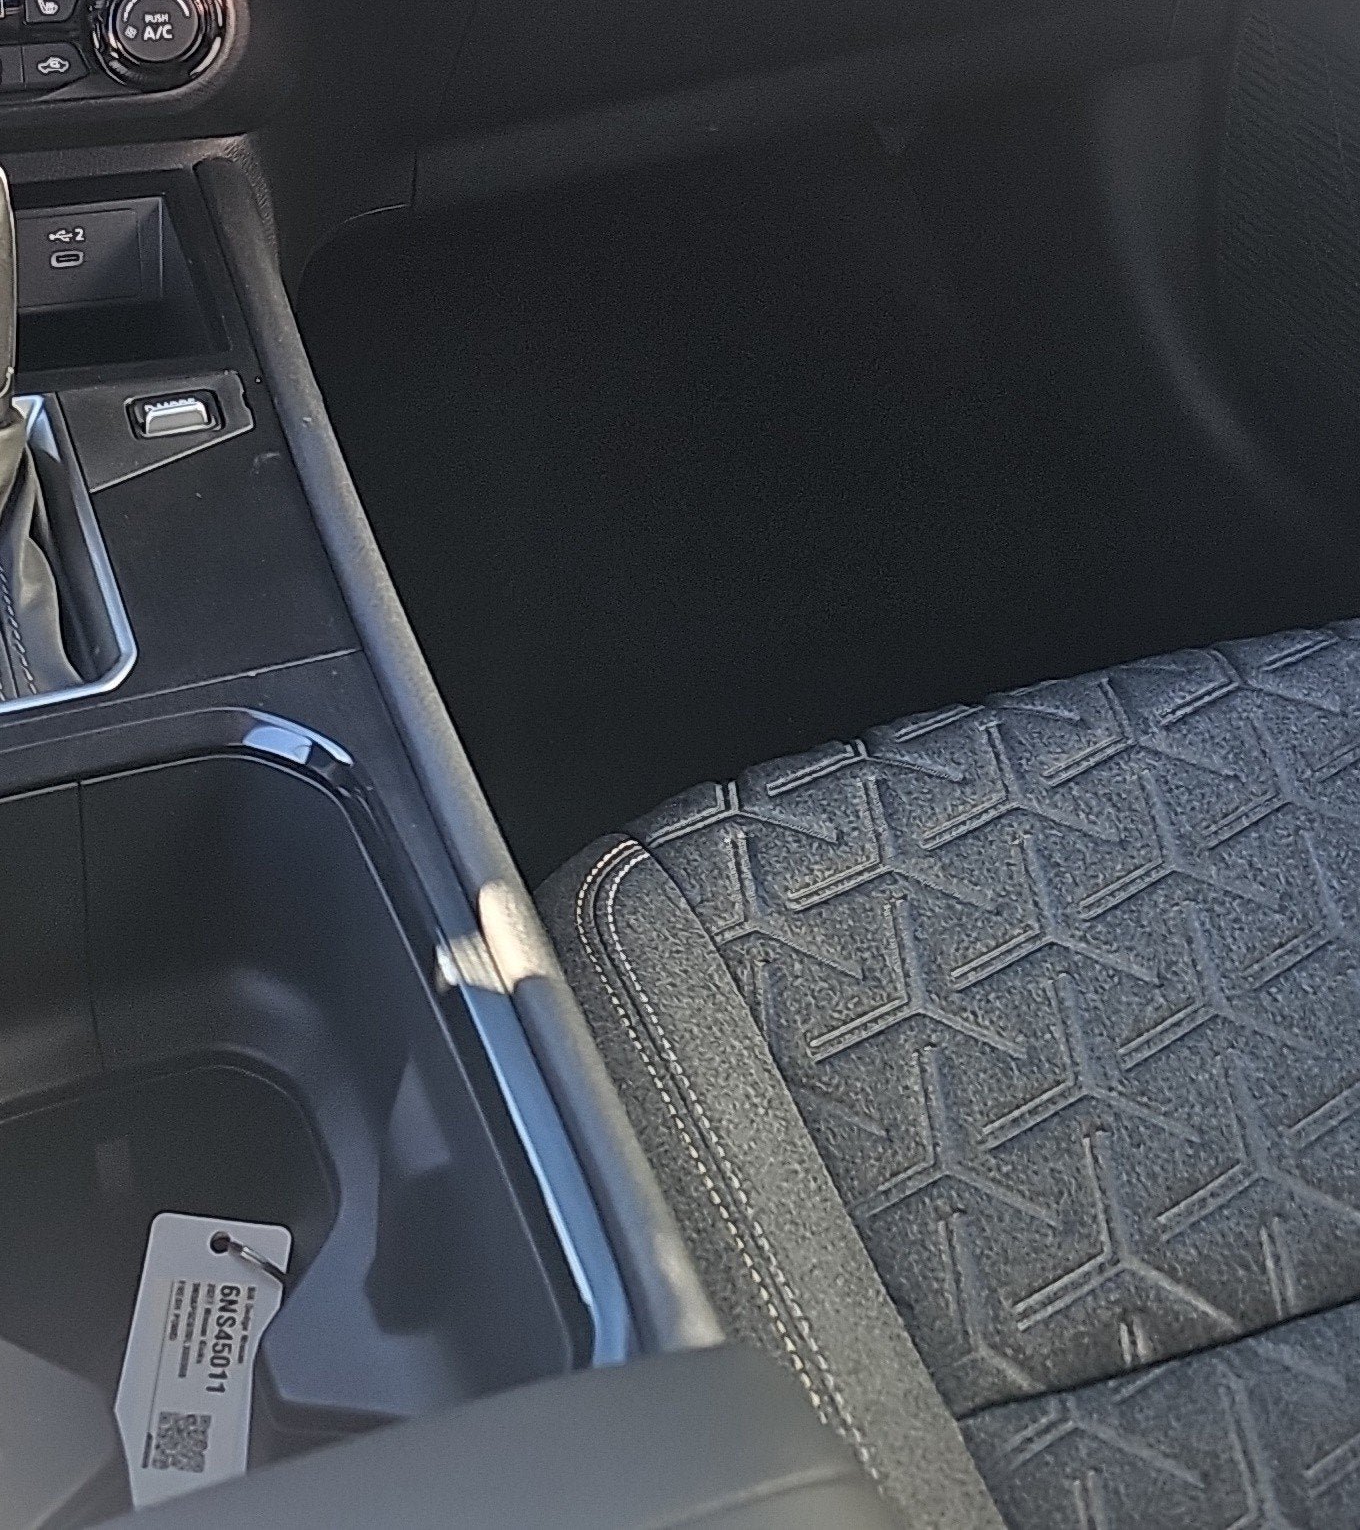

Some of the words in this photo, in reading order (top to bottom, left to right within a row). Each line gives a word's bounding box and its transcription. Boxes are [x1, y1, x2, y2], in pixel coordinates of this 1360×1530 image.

[145, 13, 170, 24] PUSH
[143, 24, 174, 40] A/C
[75, 228, 86, 242] 2
[206, 1285, 241, 1393] 6NS45011
